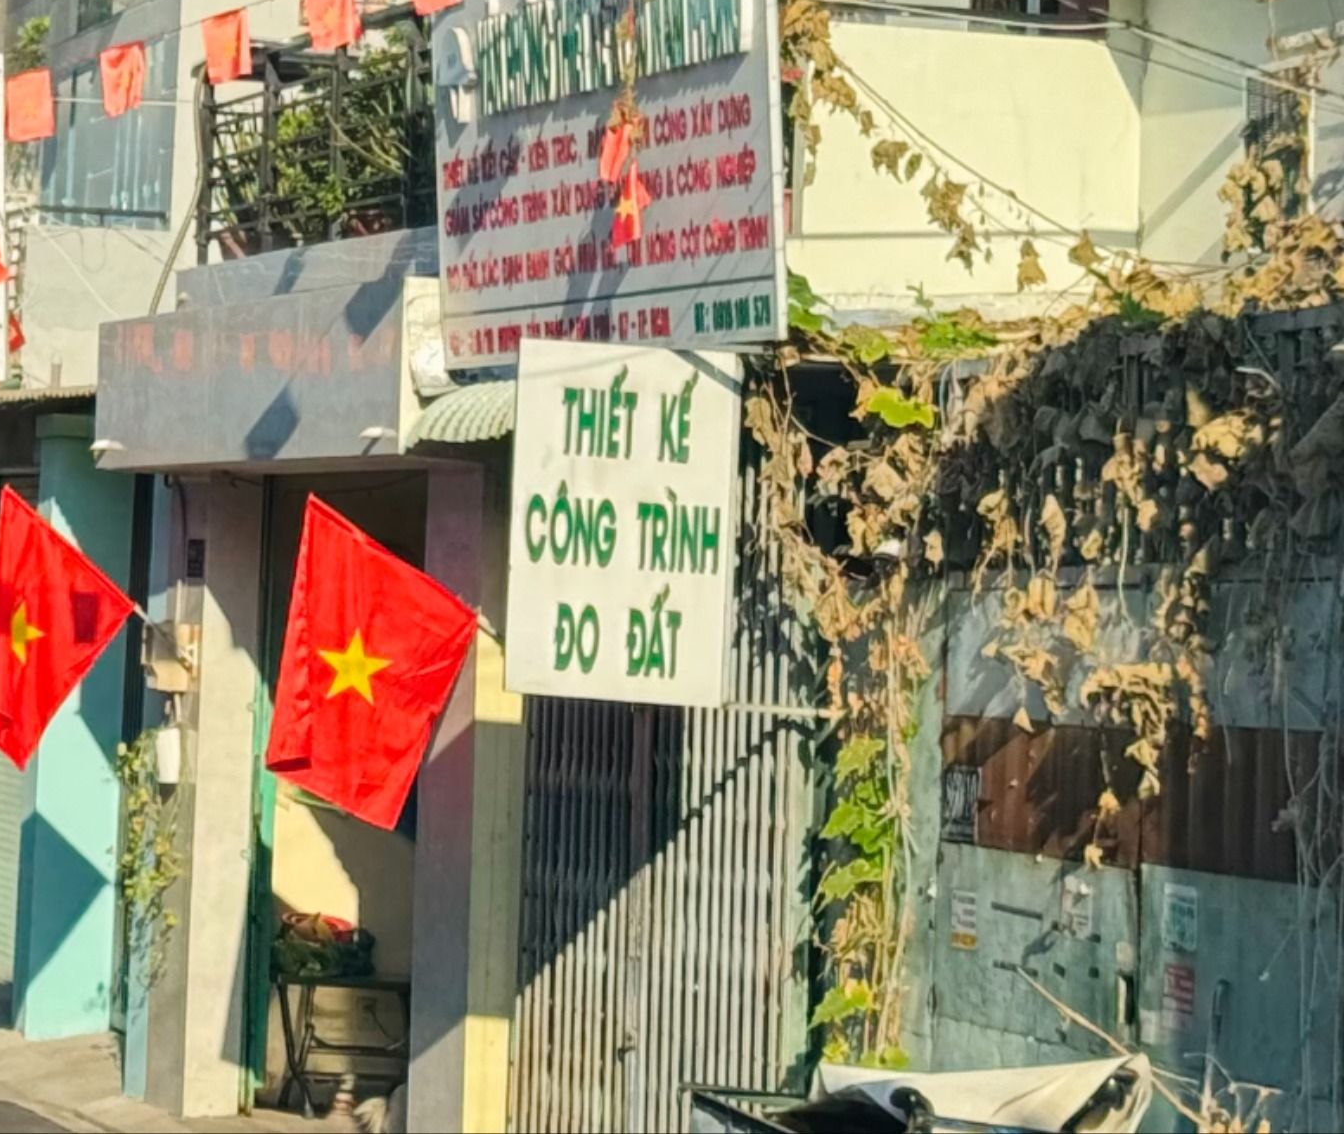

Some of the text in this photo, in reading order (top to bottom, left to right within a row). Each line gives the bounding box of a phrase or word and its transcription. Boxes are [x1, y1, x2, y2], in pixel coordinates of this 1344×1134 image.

[562, 364, 700, 464] THIẾT KẾ
[525, 479, 721, 575] CÔNG TRÌNH
[554, 583, 682, 679] ĐO ĐẤT
